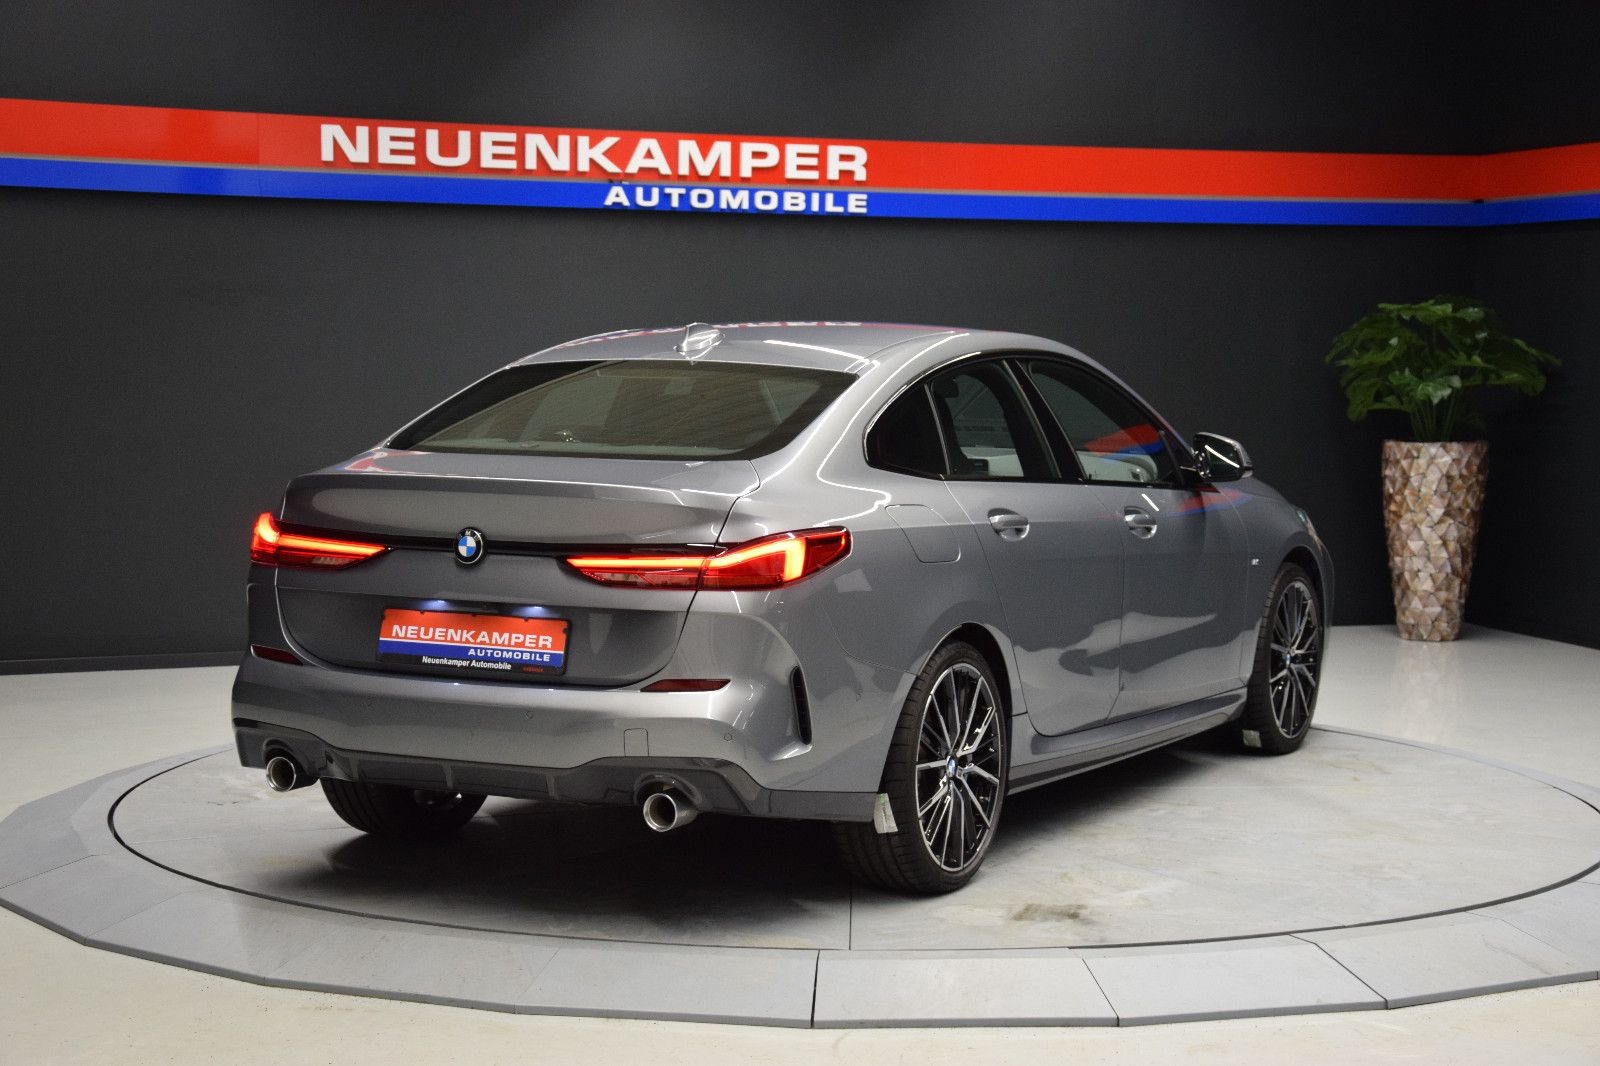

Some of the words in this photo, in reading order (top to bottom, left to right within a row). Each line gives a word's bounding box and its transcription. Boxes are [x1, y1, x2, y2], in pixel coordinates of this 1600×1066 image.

[320, 123, 868, 181] NEUENKAMPER
[604, 185, 868, 214] AUTOMOBILE
[391, 624, 553, 649] NEUENKAMPER
[422, 655, 470, 668] Neuenkamper
[470, 659, 512, 670] Automobile
[467, 648, 551, 662] AUTOMOBILE
